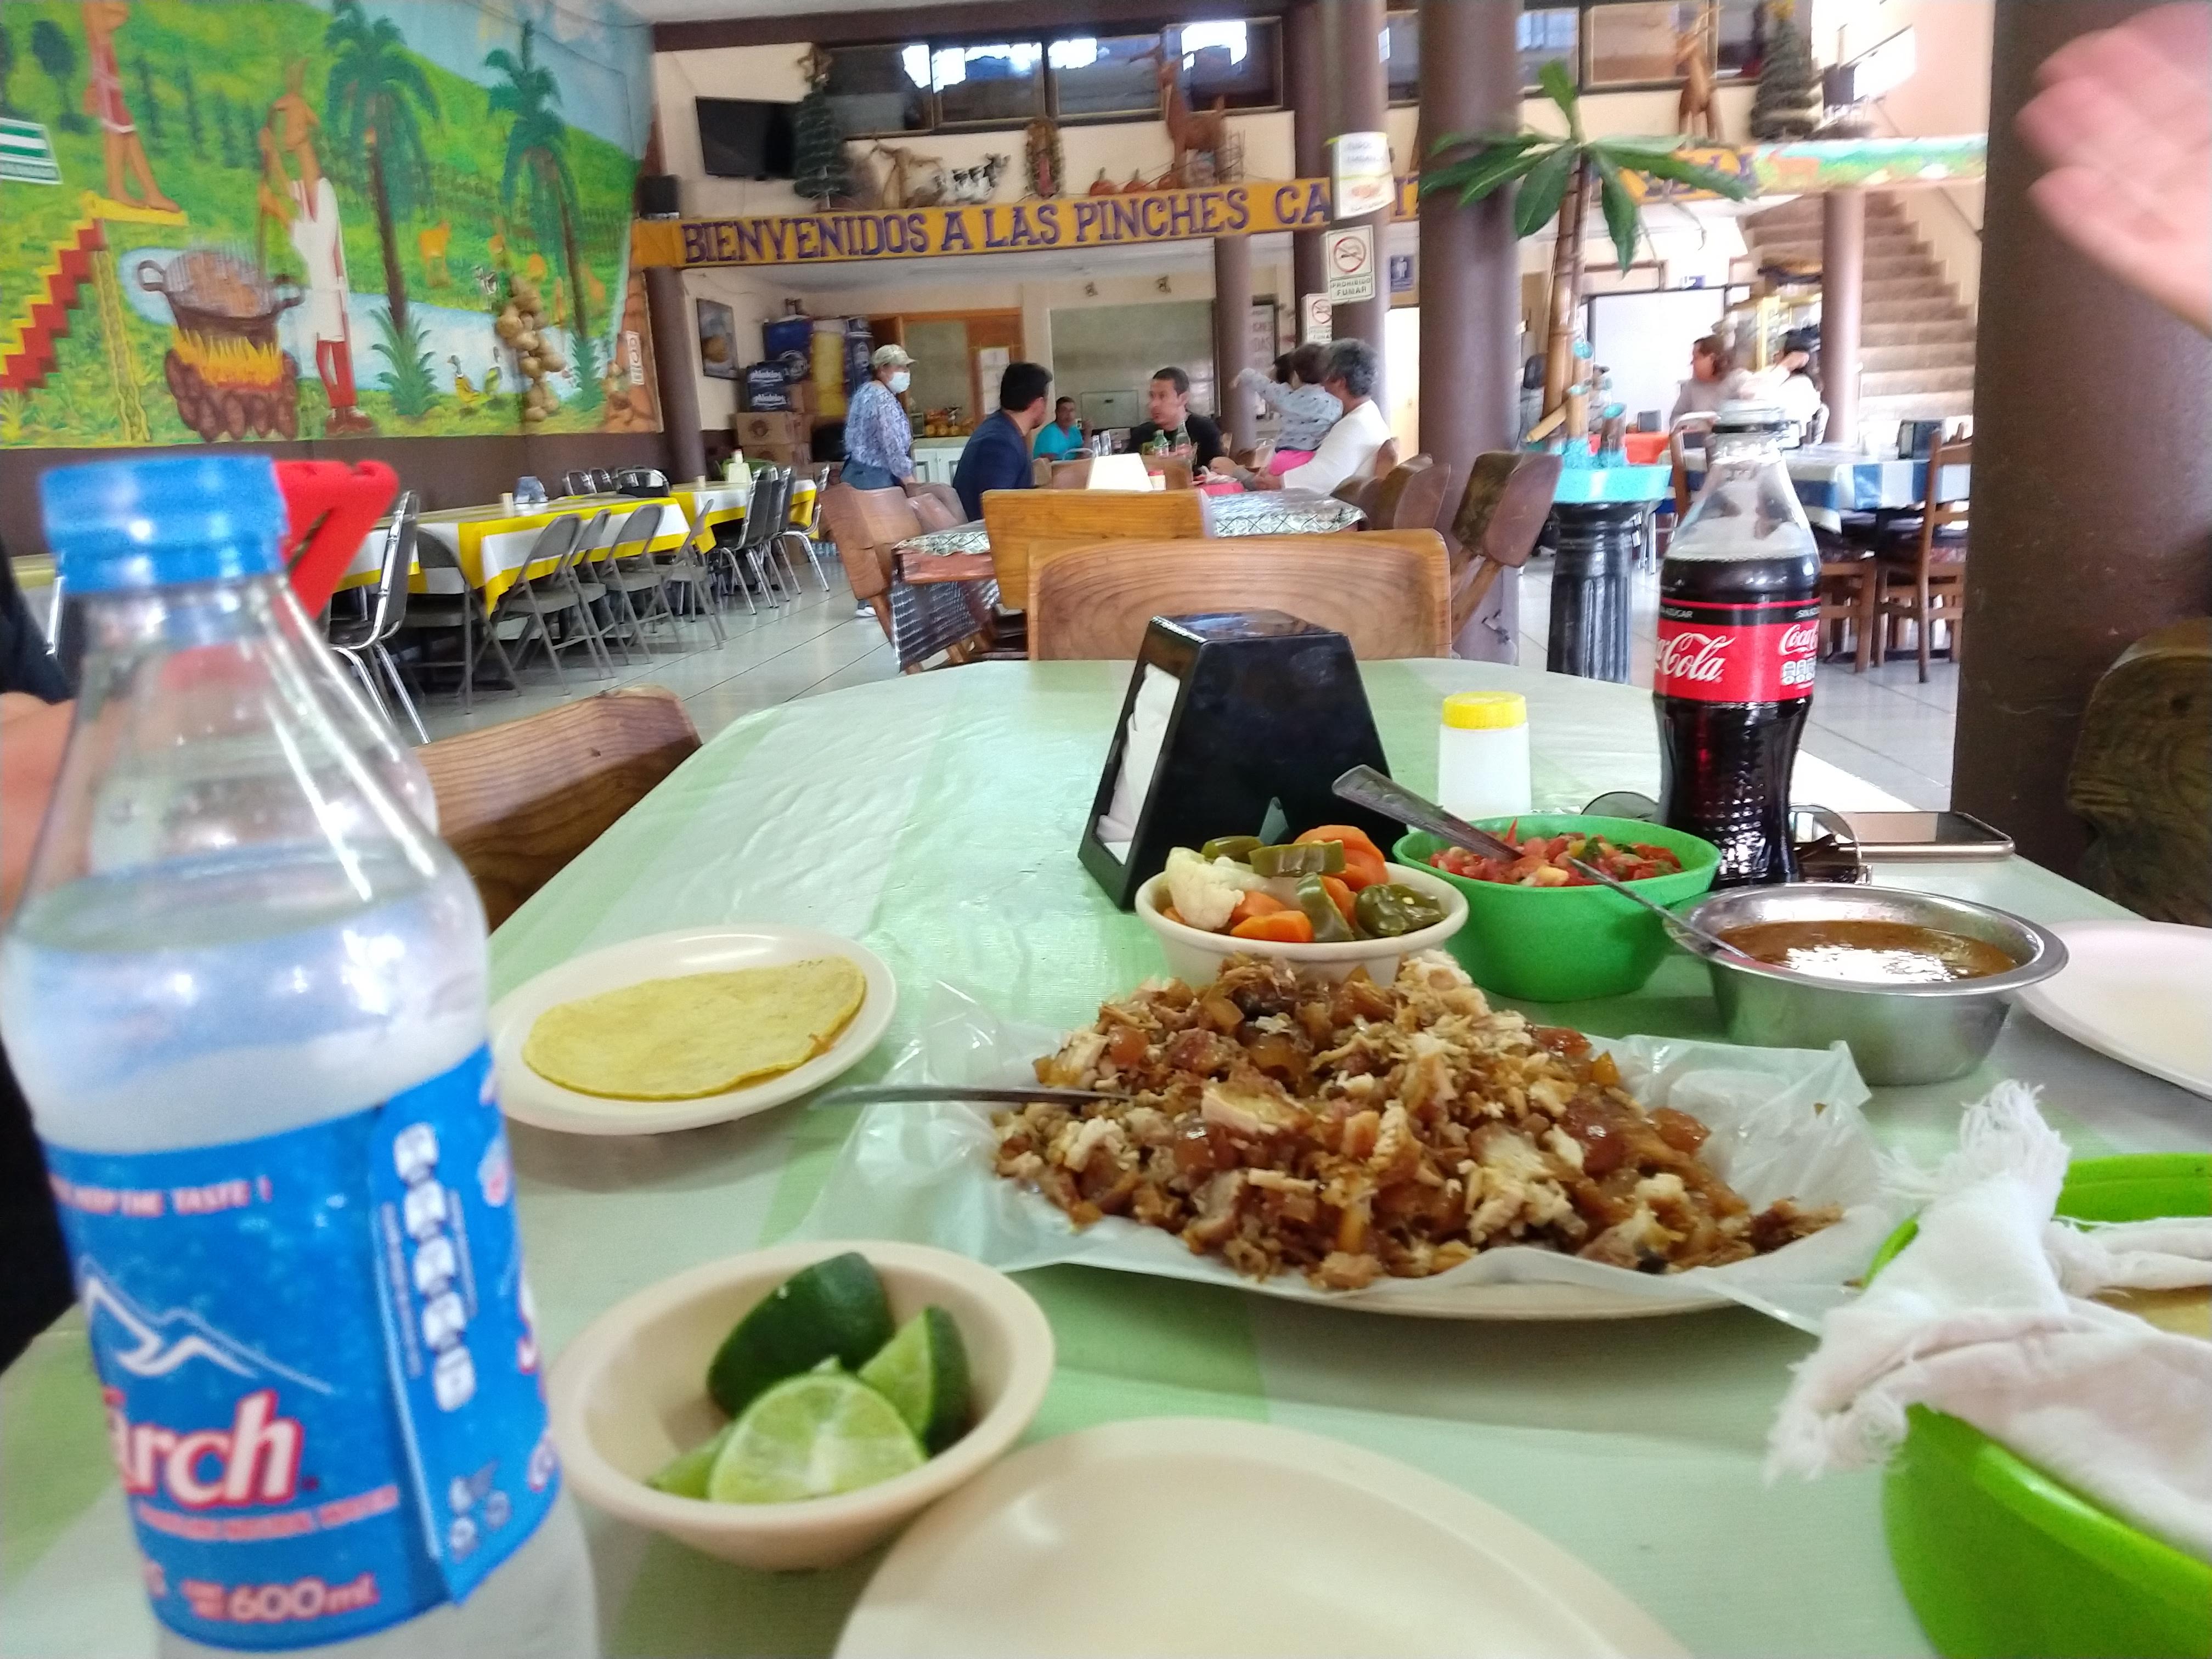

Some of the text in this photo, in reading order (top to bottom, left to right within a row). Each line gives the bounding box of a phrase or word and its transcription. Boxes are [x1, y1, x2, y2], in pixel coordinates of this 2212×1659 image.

[681, 212, 931, 264] BIENVENIDOS
[940, 210, 974, 251] A
[983, 203, 1062, 249] LAS
[1074, 187, 1250, 242] PINCHES
[1336, 286, 1367, 296] FUMAR
[173, 1179, 251, 1215] TASTE
